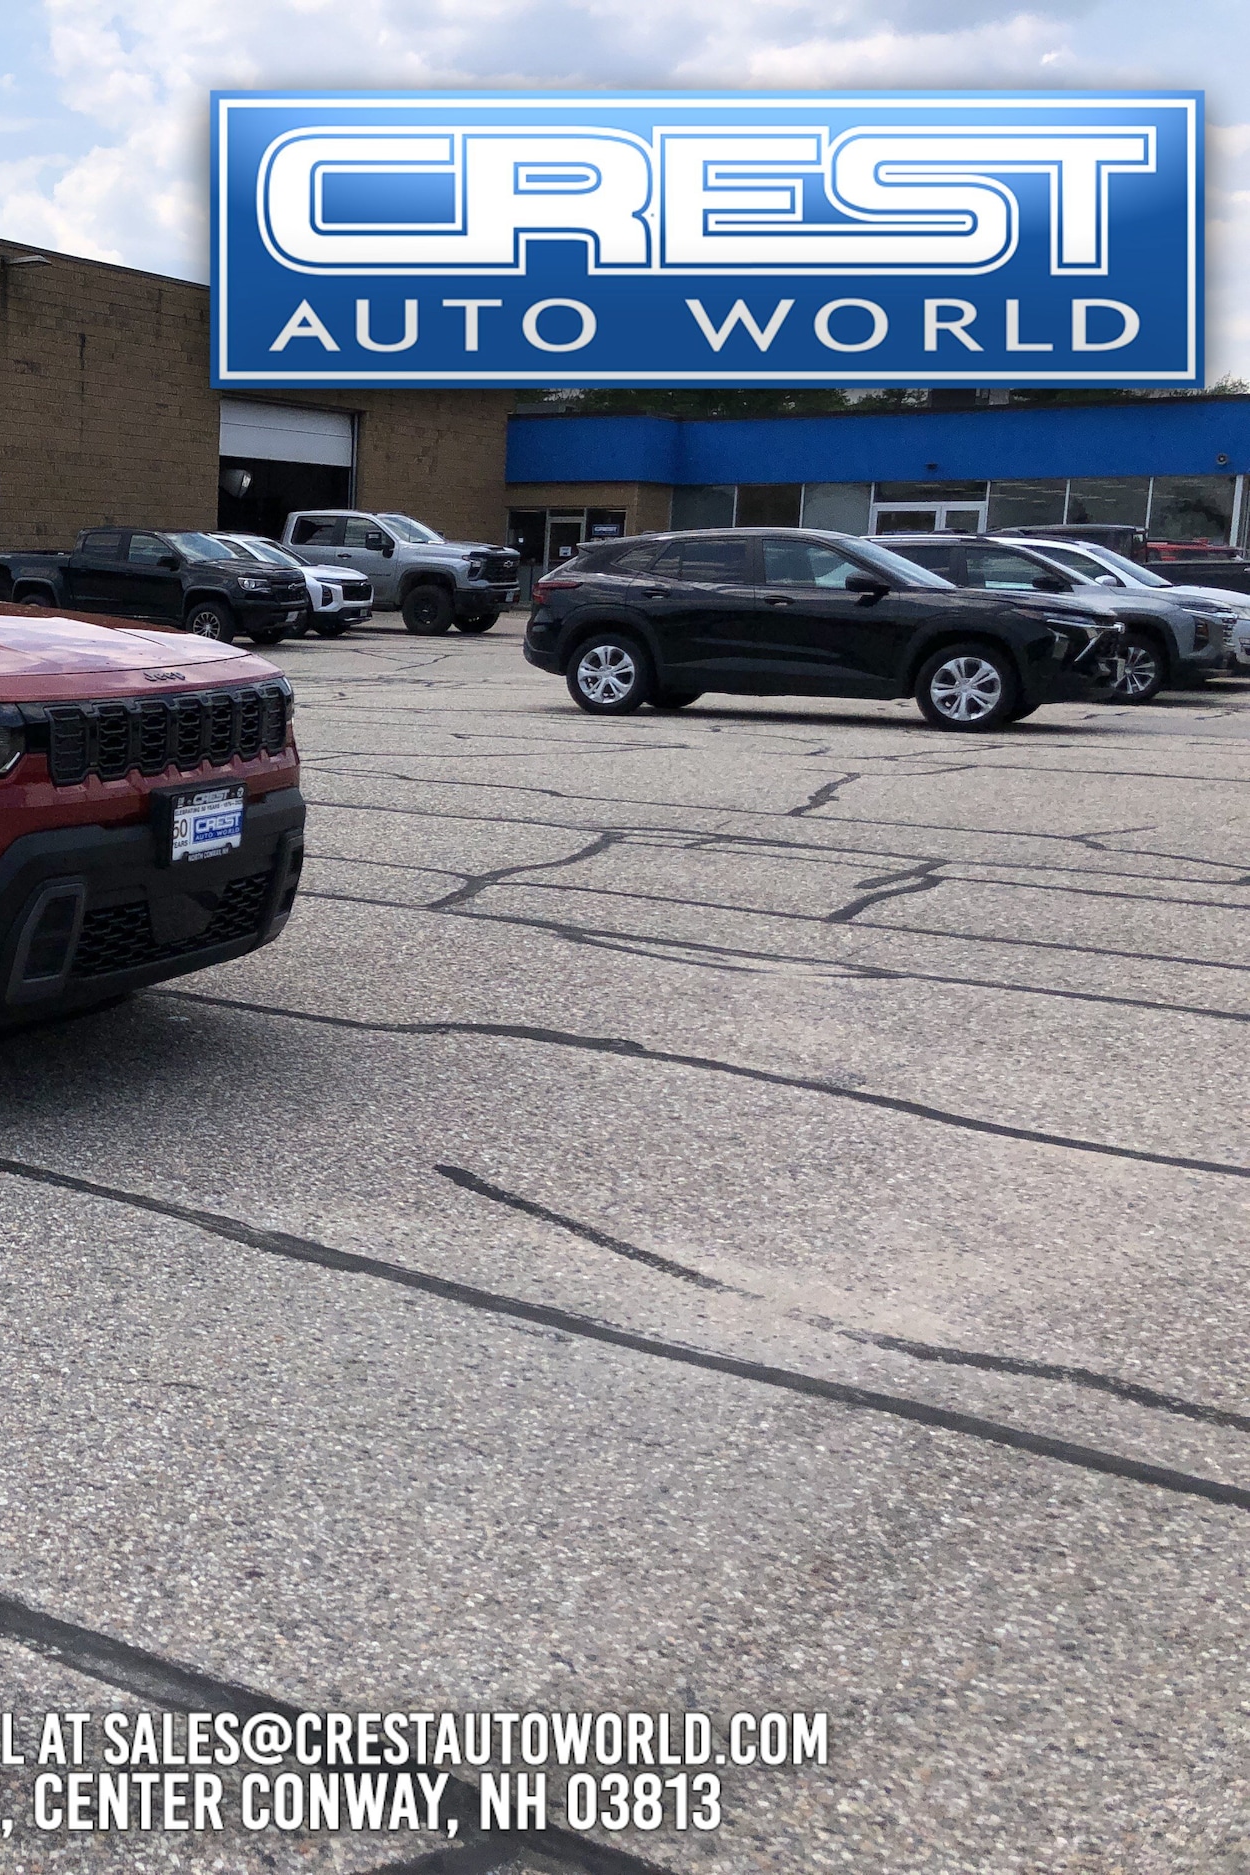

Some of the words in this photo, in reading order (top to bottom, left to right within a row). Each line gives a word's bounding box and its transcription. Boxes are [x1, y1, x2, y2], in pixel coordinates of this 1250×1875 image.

[143, 671, 186, 681] Jeep
[193, 789, 230, 804] CREST
[173, 818, 188, 840] 50
[195, 812, 241, 832] CREST
[195, 832, 214, 840] AUTO
[216, 827, 240, 835] WORLD
